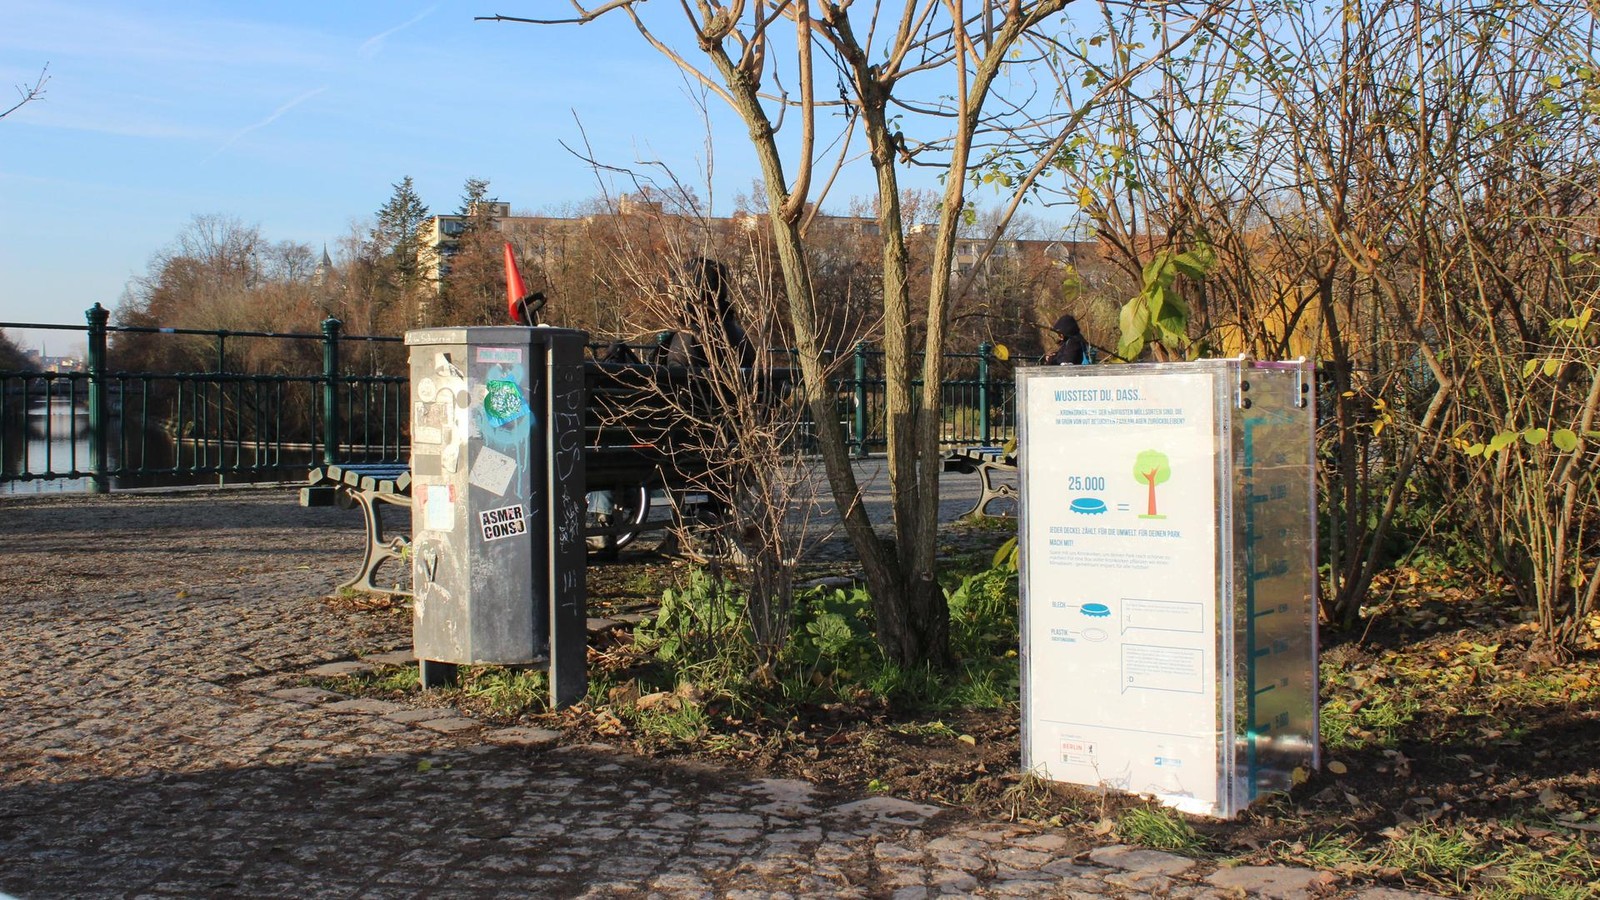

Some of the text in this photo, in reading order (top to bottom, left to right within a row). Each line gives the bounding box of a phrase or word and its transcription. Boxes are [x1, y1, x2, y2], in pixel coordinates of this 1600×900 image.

[1054, 388, 1147, 402] WUSSTEST DU, DASS...
[1068, 476, 1105, 491] 25.000
[1064, 526, 1081, 534] DECKEL
[1098, 527, 1107, 535] FÜR
[1108, 528, 1116, 536] DIE
[1138, 529, 1148, 537] FÜR
[1149, 529, 1167, 537] DEINEN
[1049, 538, 1063, 546] MACH
[1051, 628, 1068, 636] PLASTIK
